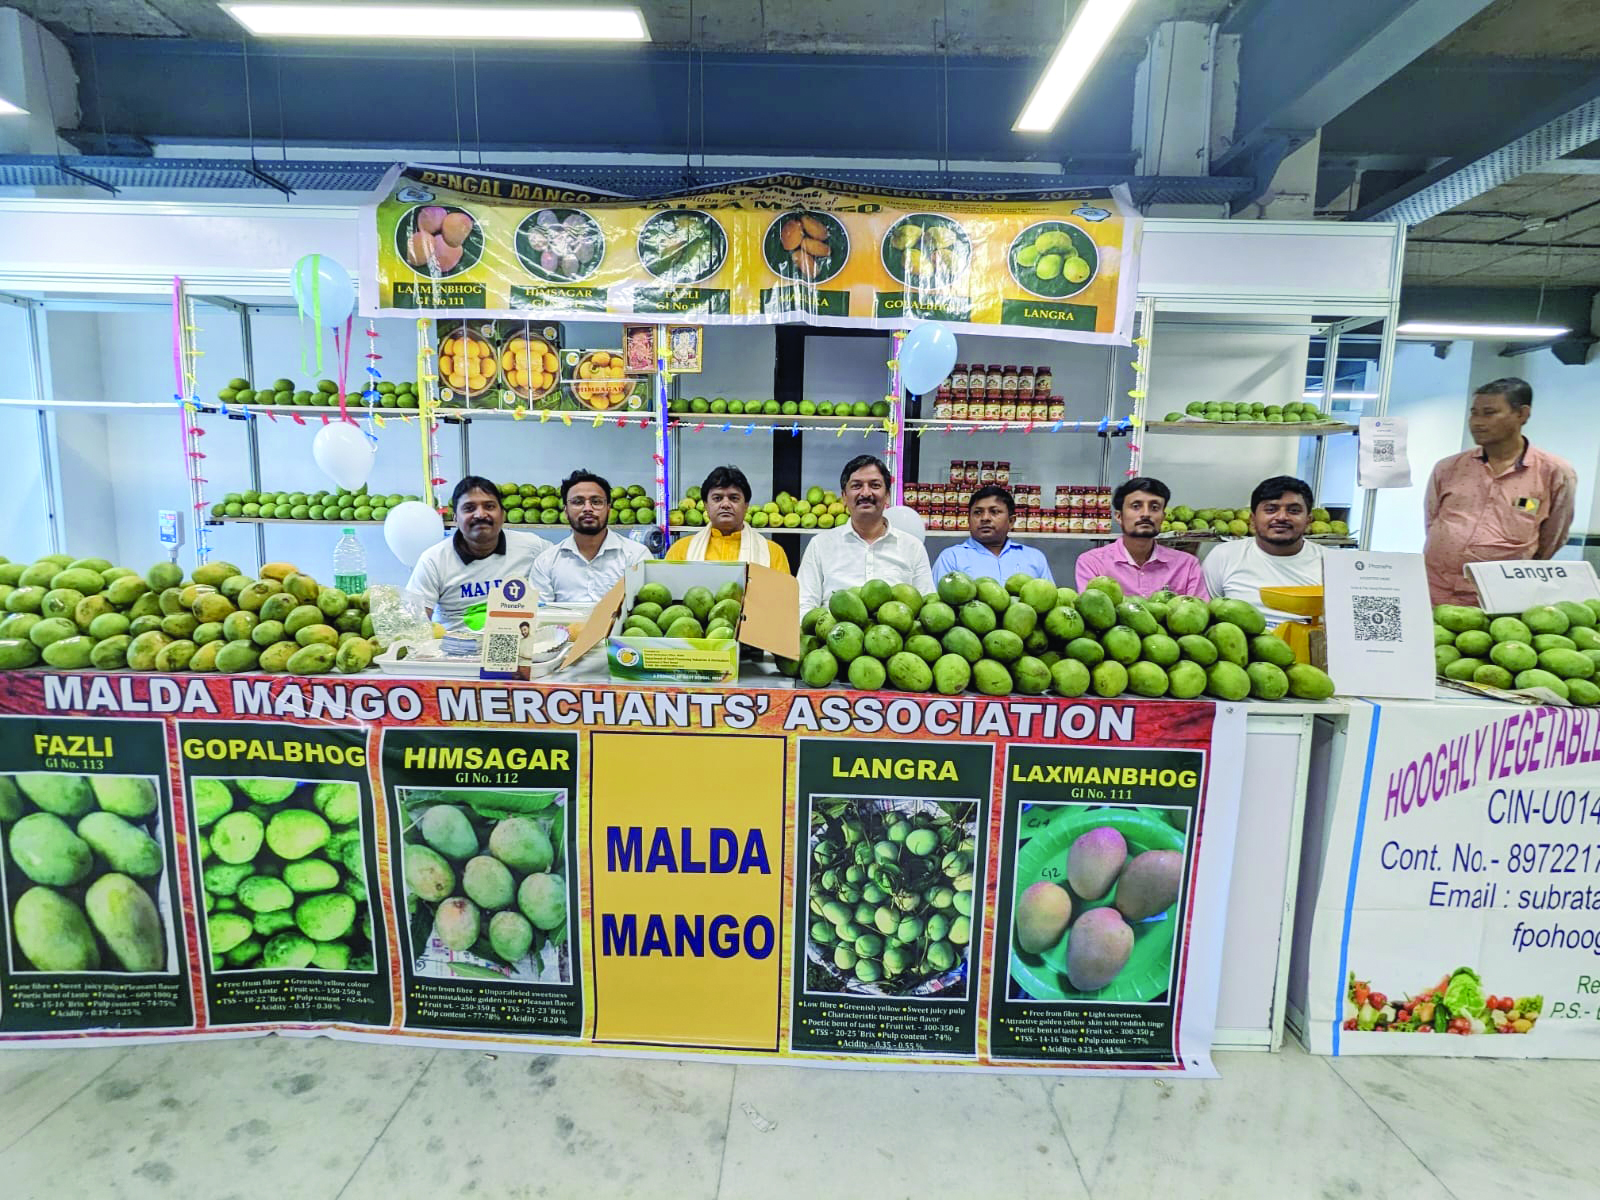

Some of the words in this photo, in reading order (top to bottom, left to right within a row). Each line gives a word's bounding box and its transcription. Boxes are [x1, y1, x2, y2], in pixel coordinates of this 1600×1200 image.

[421, 171, 503, 196] BENGAL
[511, 184, 591, 201] MANGO
[951, 193, 1008, 201] EXPO
[1039, 191, 1093, 200] 2023
[525, 287, 593, 298] HIMSAGAR
[449, 296, 464, 305] 111
[656, 301, 670, 310] GI
[672, 302, 688, 310] No
[1023, 308, 1074, 321] LANGRA
[1500, 564, 1568, 582] Langra
[460, 579, 502, 599] MAL
[43, 675, 218, 713] MALDA
[232, 679, 422, 721] MANGO
[438, 688, 768, 729] MERCHANTS'
[784, 696, 1135, 741] ASSOCIATION
[33, 734, 113, 757] FAZLI
[183, 738, 366, 766] GOPALBHOG
[46, 758, 59, 769] GI
[61, 759, 80, 770] No.
[83, 759, 104, 770] 113
[404, 747, 570, 771] HIMSAGAR
[831, 757, 959, 782] LANGRA
[1384, 725, 1488, 820] HOOGHLY
[455, 773, 470, 783] GI
[471, 773, 492, 783] No.
[495, 773, 519, 784] 112
[1011, 764, 1197, 789] LAXMANBHOG
[1071, 787, 1084, 798] GI
[1087, 788, 1107, 799] No.
[1110, 789, 1132, 800] 111
[606, 826, 772, 874] MALDA
[1380, 841, 1442, 871] Cont.
[1452, 843, 1500, 873] No.-
[1429, 881, 1496, 908] Email
[1504, 889, 1510, 908] :
[1518, 884, 1600, 911] subrata
[602, 913, 775, 960] MANGO
[421, 984, 438, 992] Free
[1577, 975, 1600, 994] Re
[820, 1001, 838, 1009] fibre
[844, 1003, 876, 1011] Greenish
[907, 1005, 929, 1014] Sweet
[930, 1007, 947, 1015] juicy
[948, 1007, 966, 1016] pulp
[1029, 1009, 1045, 1017] Free
[1063, 1010, 1080, 1018] fibre
[1088, 1011, 1106, 1019] Light
[423, 1009, 439, 1018] Pulp
[512, 1014, 537, 1023] Acidity
[827, 1010, 878, 1020] Characteristic
[879, 1013, 919, 1022] turpentine
[919, 1015, 941, 1023] flavor
[1005, 1017, 1038, 1025] Attractive
[1038, 1018, 1062, 1026] golden
[808, 1018, 830, 1026] Poetic
[849, 1020, 858, 1028] of
[885, 1022, 904, 1030] Fruit
[1015, 1026, 1036, 1034] Poetic
[815, 1028, 829, 1036] TSS
[882, 1031, 899, 1040] Pulp
[900, 1033, 928, 1041] content
[1084, 1036, 1100, 1045] Pulp
[842, 1039, 867, 1049] Acidity
[1047, 1045, 1072, 1055] Acidity
